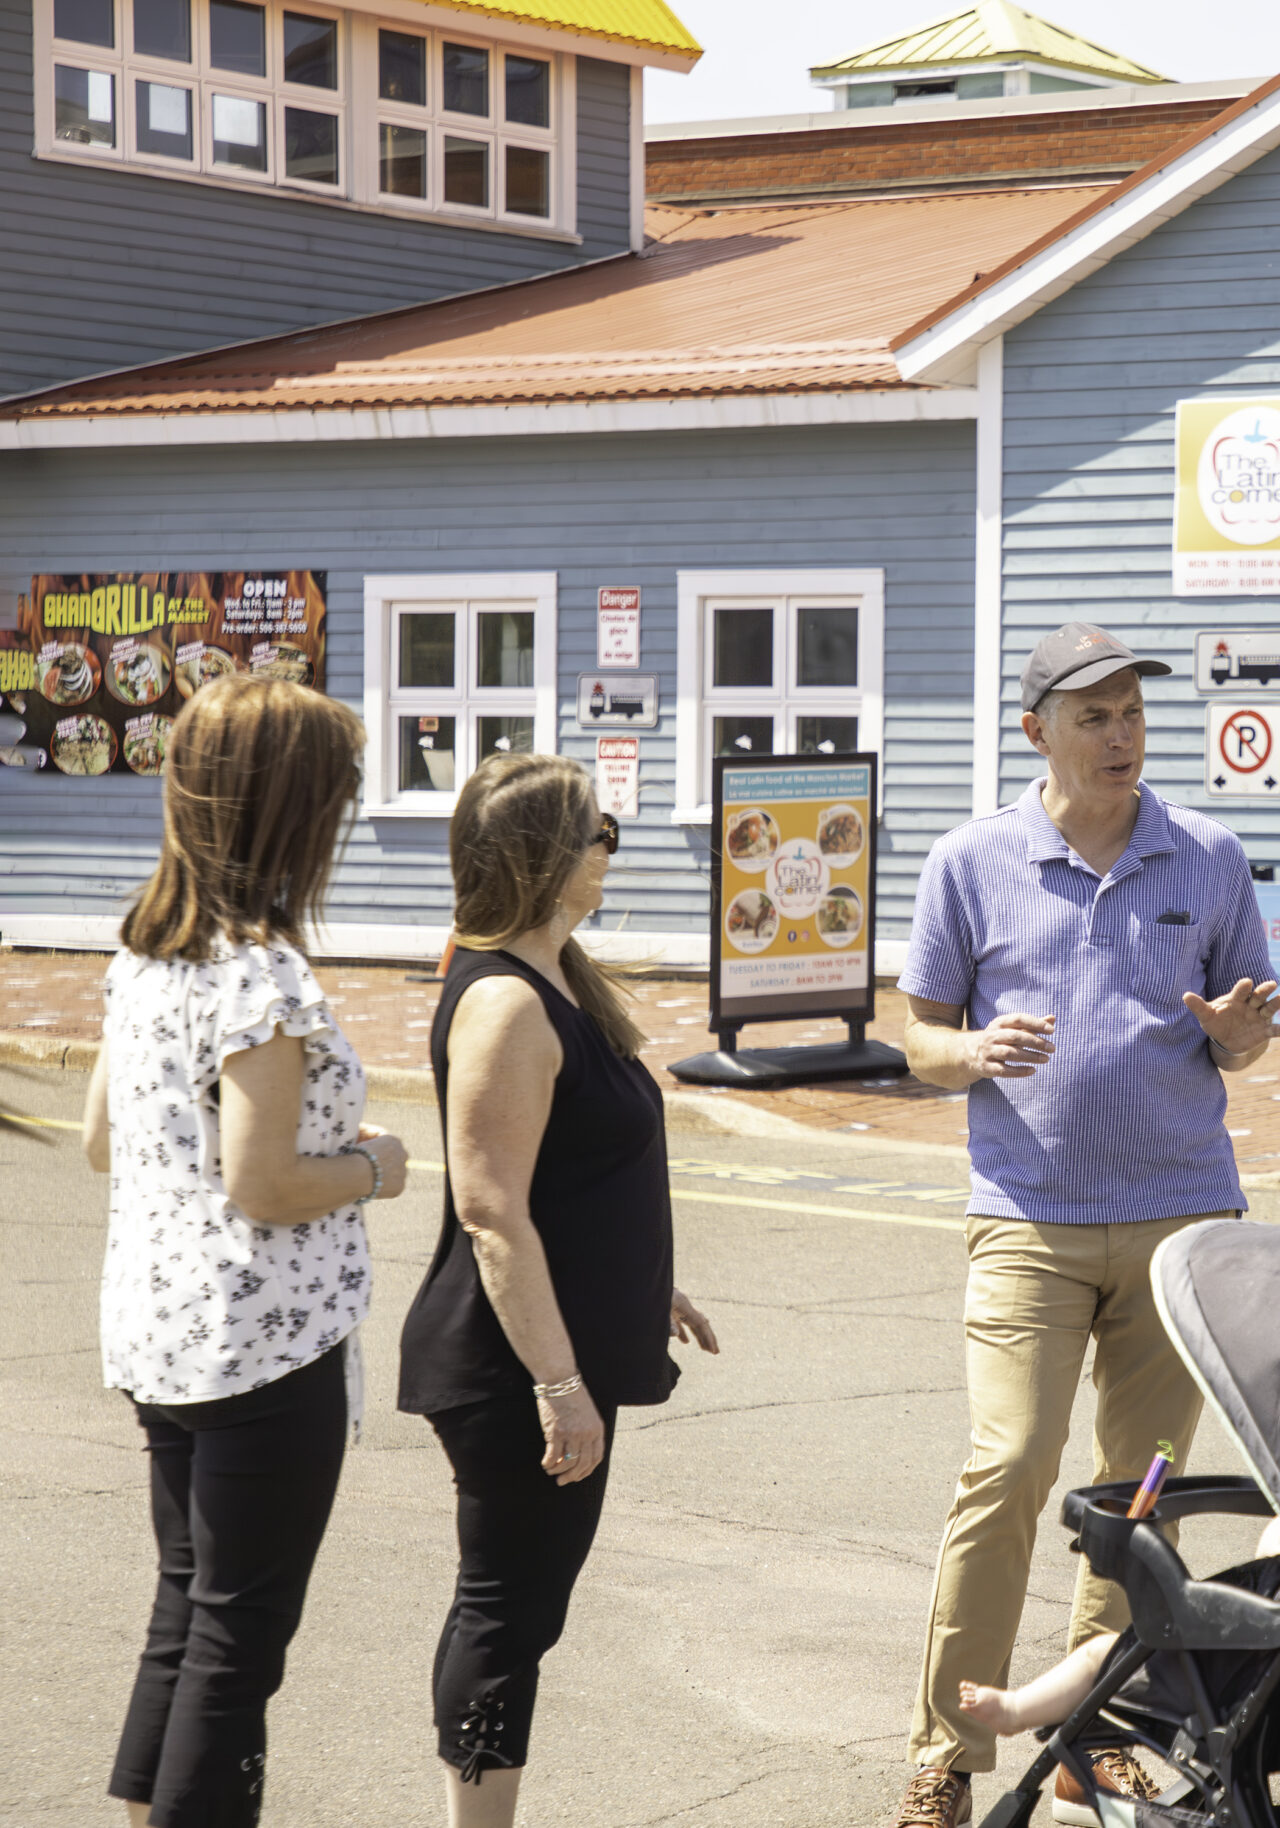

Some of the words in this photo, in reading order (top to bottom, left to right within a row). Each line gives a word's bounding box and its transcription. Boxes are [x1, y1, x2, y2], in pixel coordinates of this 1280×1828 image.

[1222, 454, 1267, 470] The
[243, 580, 288, 598] OPEN
[168, 598, 183, 611] AT
[184, 598, 204, 611] THE
[602, 591, 637, 608] Danger
[168, 611, 211, 624] MARKET
[1239, 726, 1256, 758] P
[729, 776, 746, 785] Real
[766, 775, 783, 785] food
[778, 875, 818, 887] Latin
[729, 964, 764, 974] TUESDAY
[766, 963, 777, 972] TO
[778, 962, 806, 971] FRIDAY
[750, 977, 790, 988] SATURDAY
